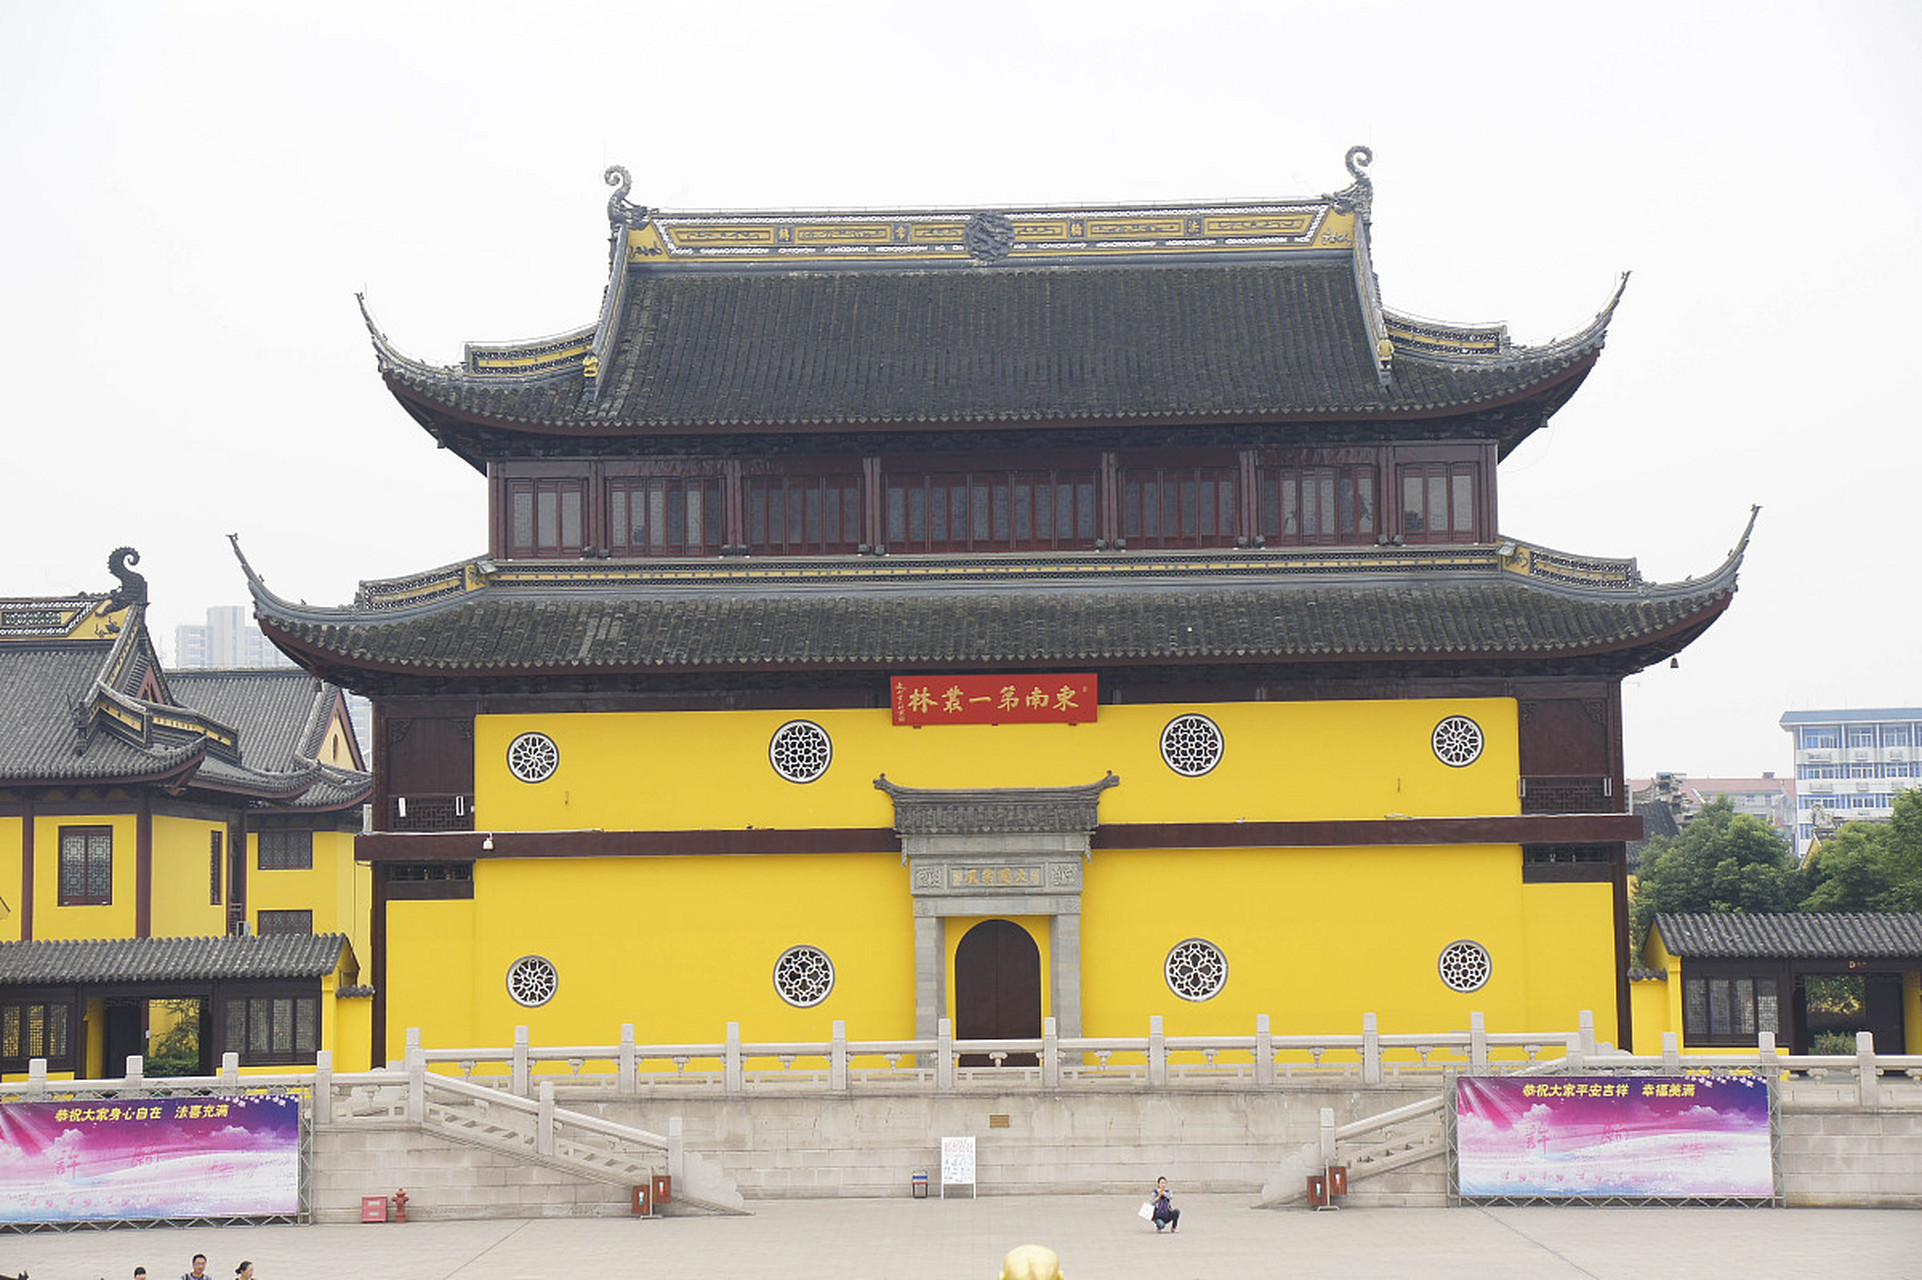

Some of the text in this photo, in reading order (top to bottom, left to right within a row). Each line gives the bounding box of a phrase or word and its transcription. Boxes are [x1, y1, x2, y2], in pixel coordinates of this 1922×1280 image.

[908, 685, 1079, 713] 東南第一叢林
[1522, 1083, 1696, 1098] 恭祝大家平安吉祥 幸福美满
[54, 1105, 229, 1122] 恭祝大家身心自在 法喜充满
